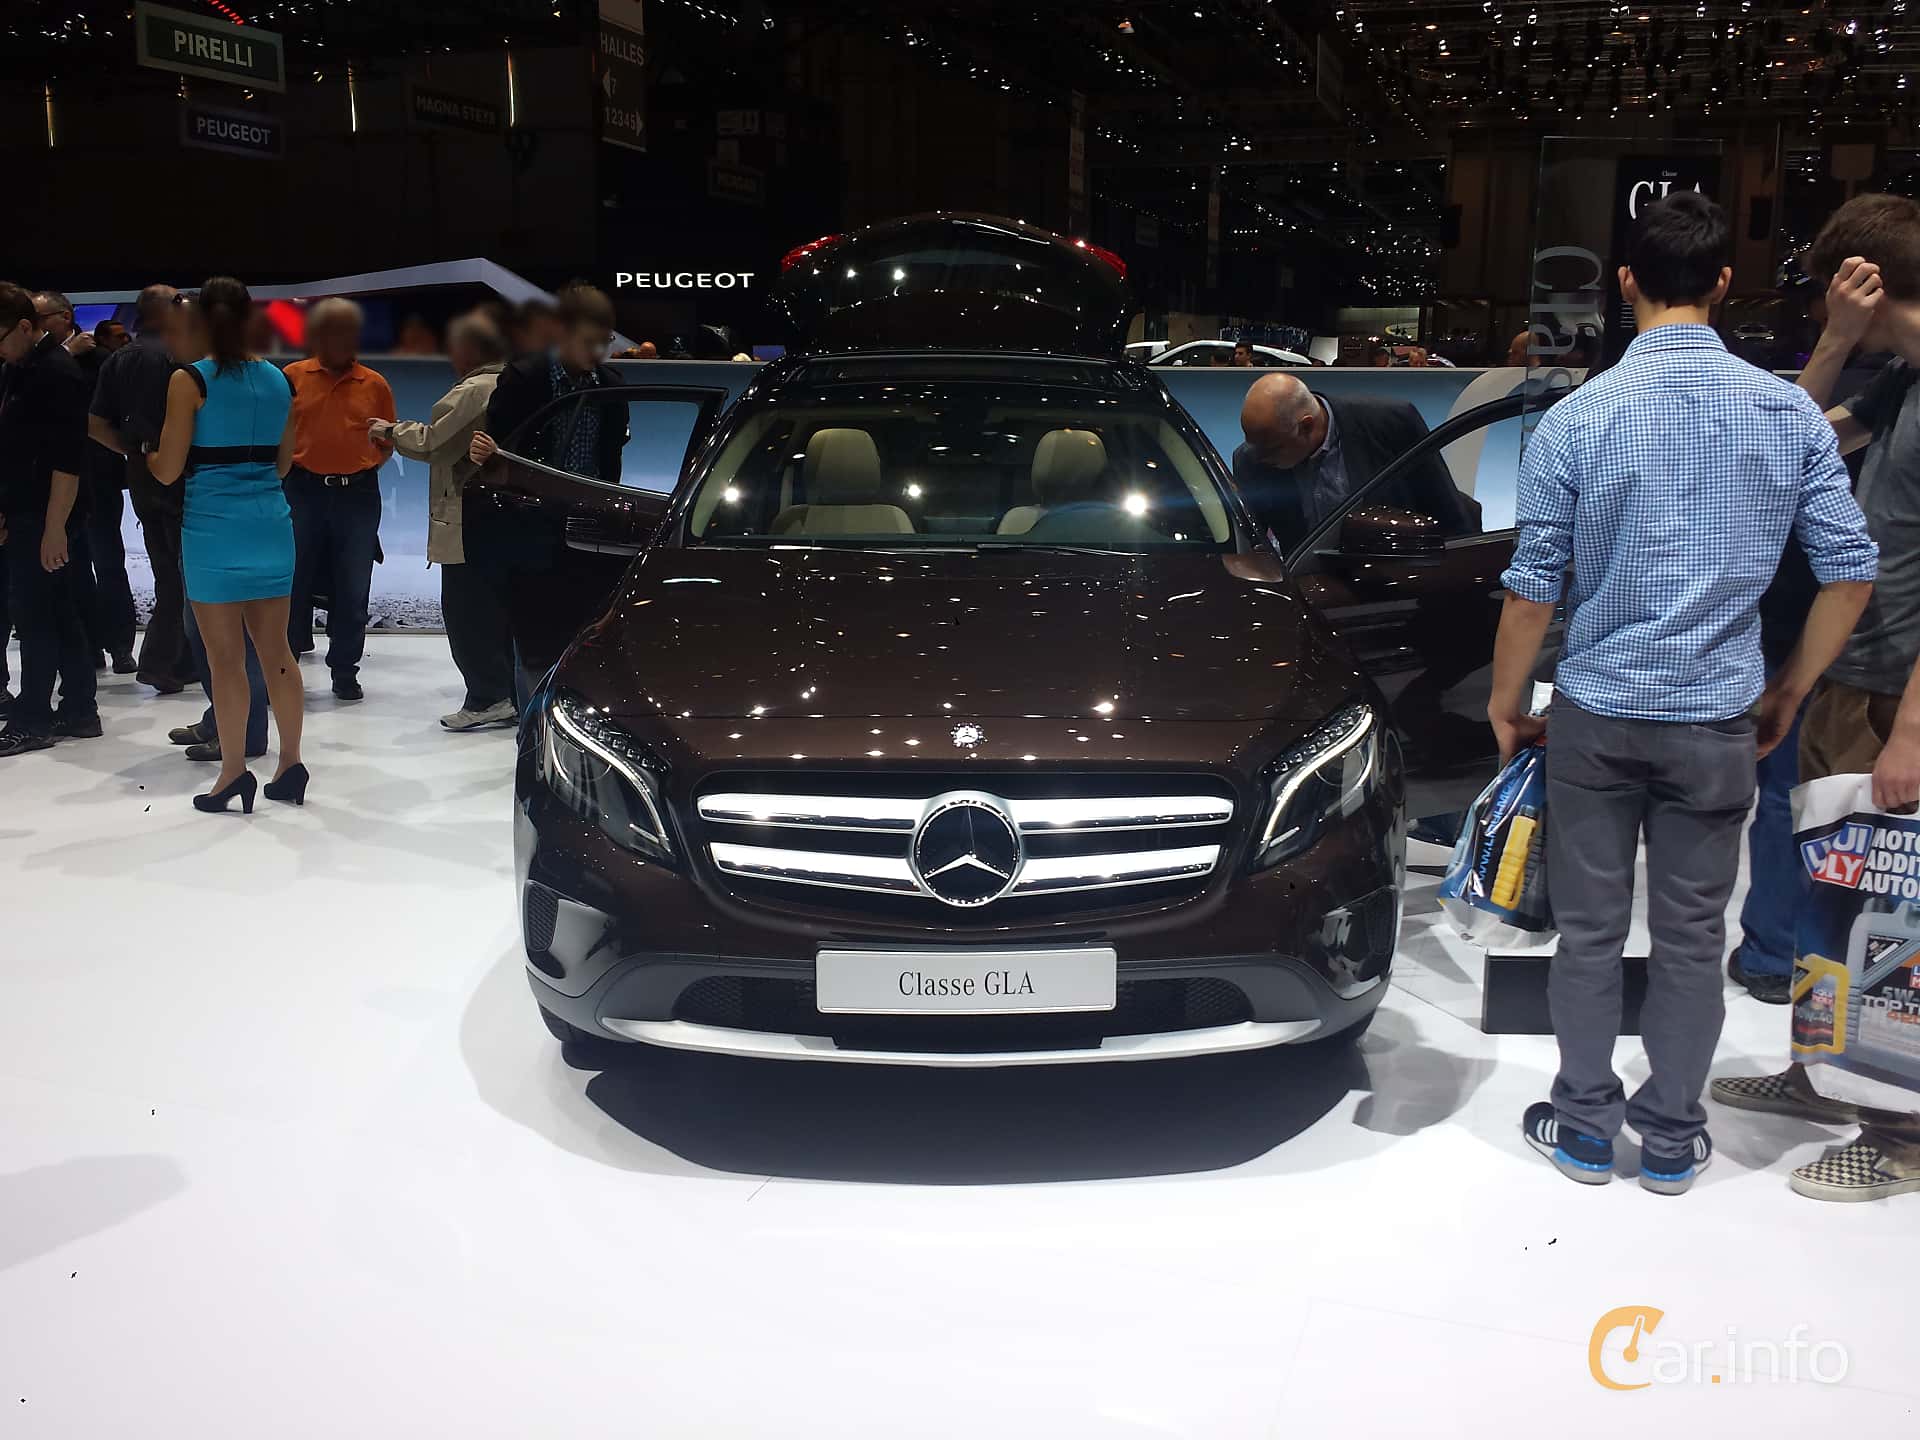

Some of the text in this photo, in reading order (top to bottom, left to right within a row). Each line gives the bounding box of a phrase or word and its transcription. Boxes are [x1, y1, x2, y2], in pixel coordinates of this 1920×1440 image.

[173, 29, 253, 68] PIRELLI
[600, 31, 645, 68] HALLES
[196, 115, 272, 145] PEUGEOT
[604, 106, 638, 133] 12345
[615, 271, 755, 289] PEUGEOT
[1858, 871, 1920, 900] AUTO
[898, 970, 1036, 996] Classe GLA
[1861, 994, 1903, 1011] TOP
